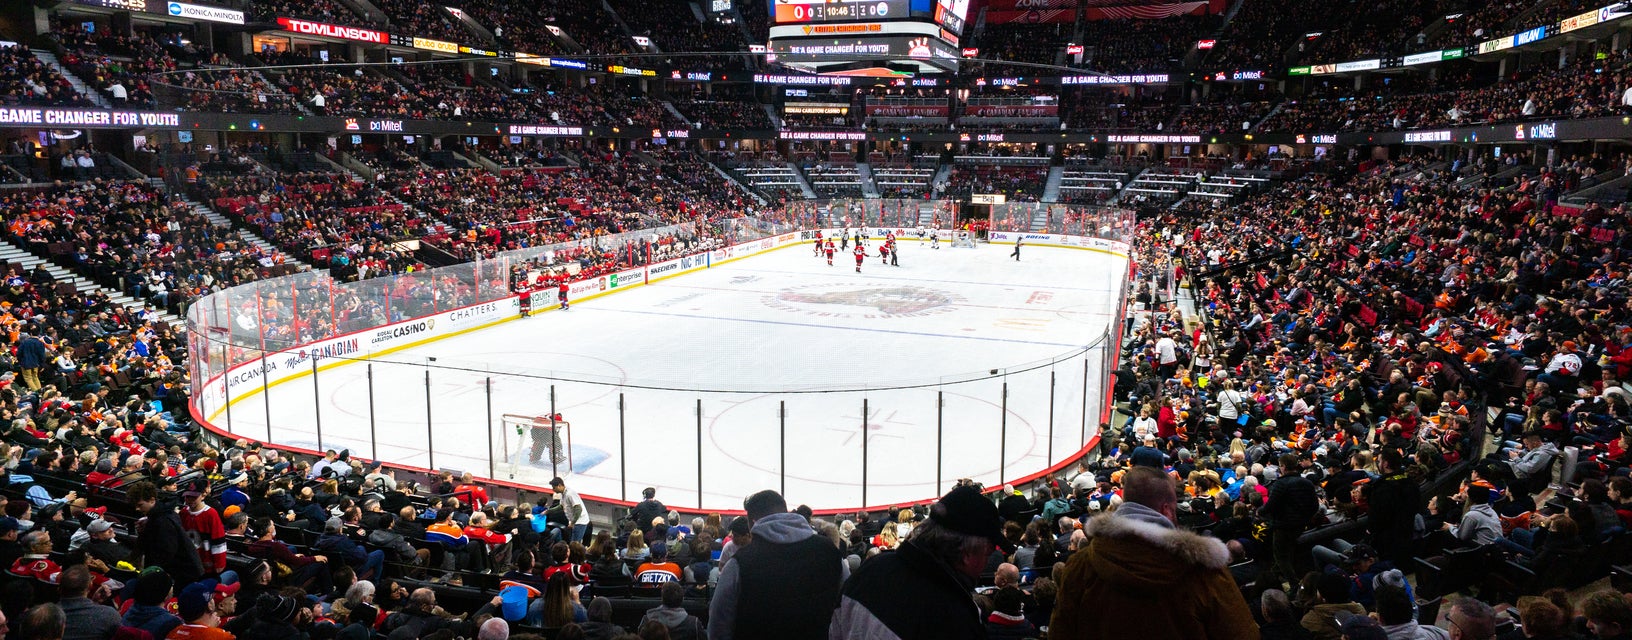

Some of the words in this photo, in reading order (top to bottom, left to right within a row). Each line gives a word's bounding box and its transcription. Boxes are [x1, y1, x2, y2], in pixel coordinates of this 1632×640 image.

[184, 7, 212, 18] KONICA
[213, 10, 244, 22] MINOLTA
[794, 6, 803, 18] 0
[807, 8, 814, 17] 0
[827, 6, 848, 15] 10:46
[870, 6, 876, 15] 0
[288, 20, 380, 42] TOMLINSON
[868, 44, 889, 52] YOUTH
[786, 76, 816, 84] CHANGER
[830, 77, 851, 85] YOUTH
[1099, 75, 1131, 83] CHANGER
[0, 109, 41, 123] GAME
[46, 110, 110, 124] CHANGER
[114, 112, 138, 125] FOR
[140, 113, 178, 126] YOUTH
[381, 121, 402, 132] Mitel
[1538, 123, 1557, 138] Mitel
[1320, 134, 1336, 143] Mitel
[681, 257, 692, 270] NIC
[695, 254, 705, 266] HIT
[650, 263, 678, 274] SKECHERS
[612, 272, 642, 284] enterprise
[450, 303, 496, 321] CHATTERS
[312, 338, 358, 361] CANADIAN
[229, 376, 240, 387] AIR
[240, 362, 277, 382] CANADA
[642, 572, 672, 583] GRETZKY
